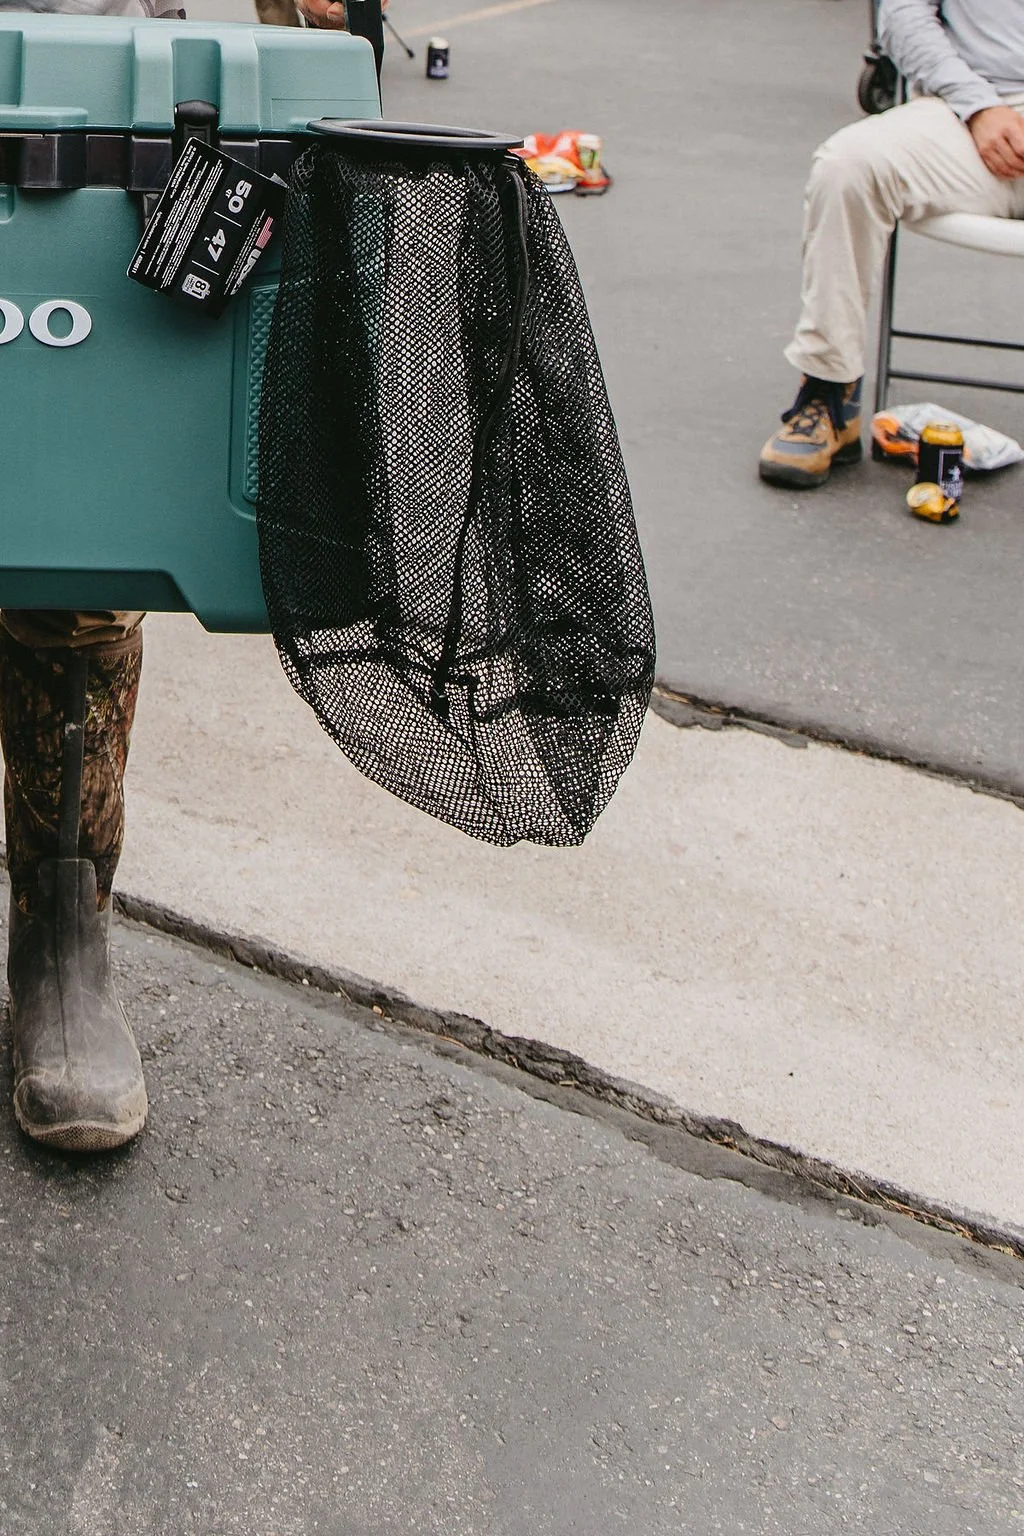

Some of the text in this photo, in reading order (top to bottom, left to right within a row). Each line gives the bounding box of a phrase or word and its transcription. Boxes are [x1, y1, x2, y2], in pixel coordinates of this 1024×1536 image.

[228, 179, 253, 213] 50
[207, 228, 226, 262] 47
[192, 280, 207, 297] 81
